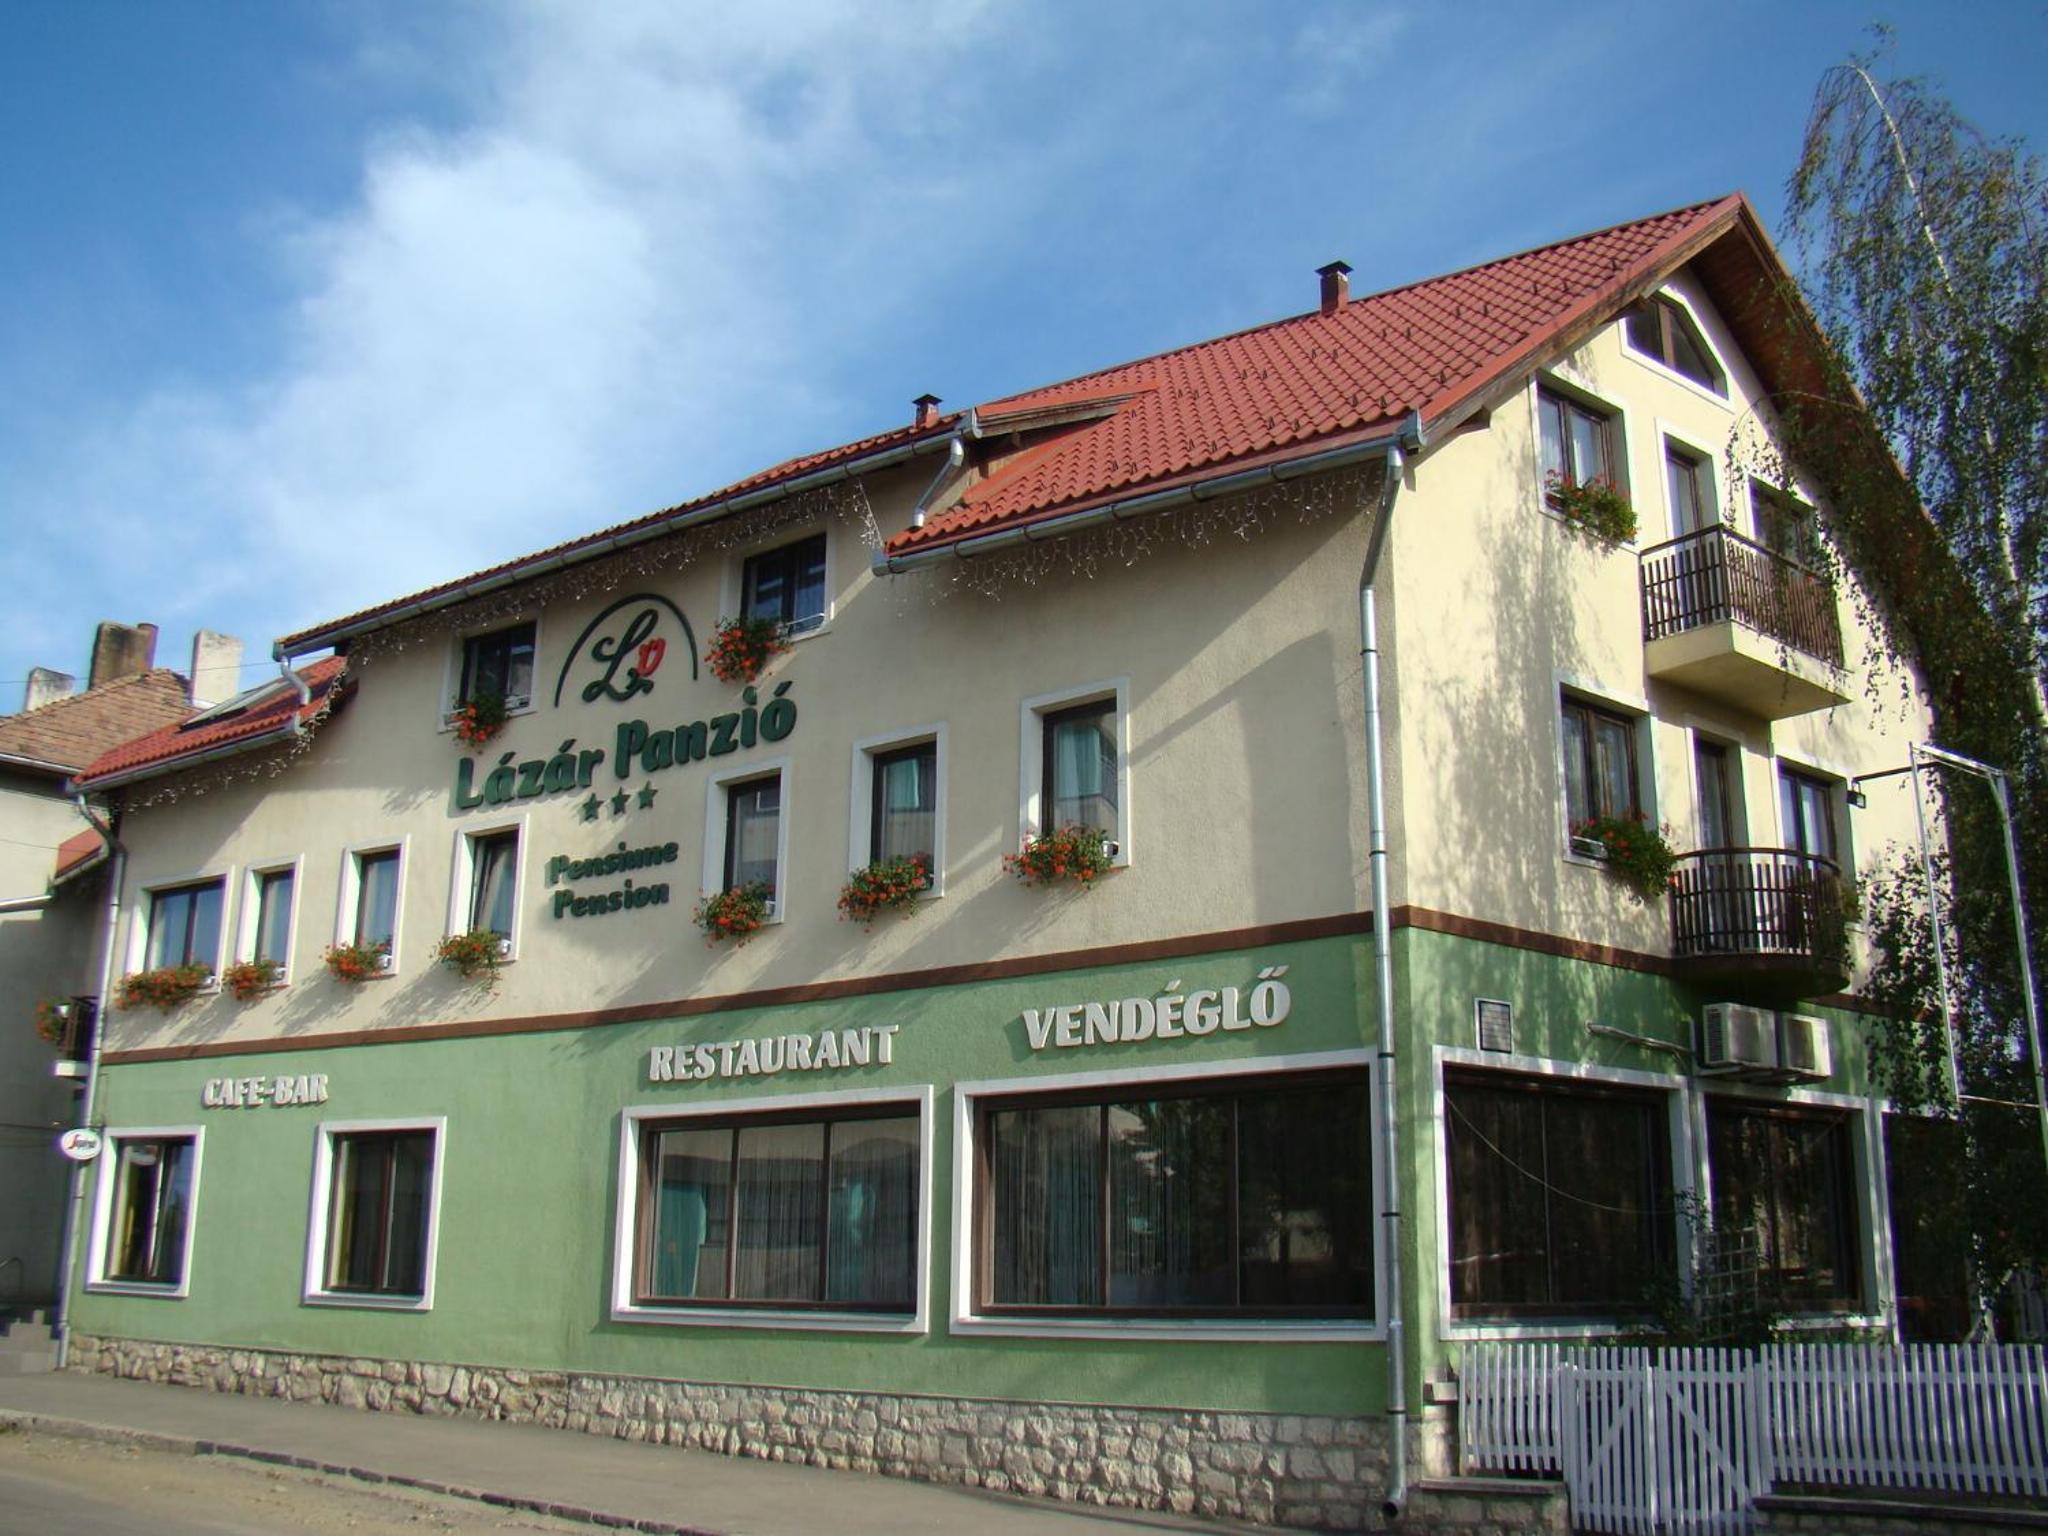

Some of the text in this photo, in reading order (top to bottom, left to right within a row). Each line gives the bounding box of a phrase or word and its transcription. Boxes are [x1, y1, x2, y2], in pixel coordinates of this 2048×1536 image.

[455, 680, 798, 811] Lázár Panzió
[550, 841, 679, 885] Pensiune
[554, 878, 670, 918] Pension
[1022, 965, 1291, 1050] VENDÉGLŐ
[649, 1024, 899, 1082] RESTAURANT
[203, 1073, 329, 1107] CAFE-BAR
